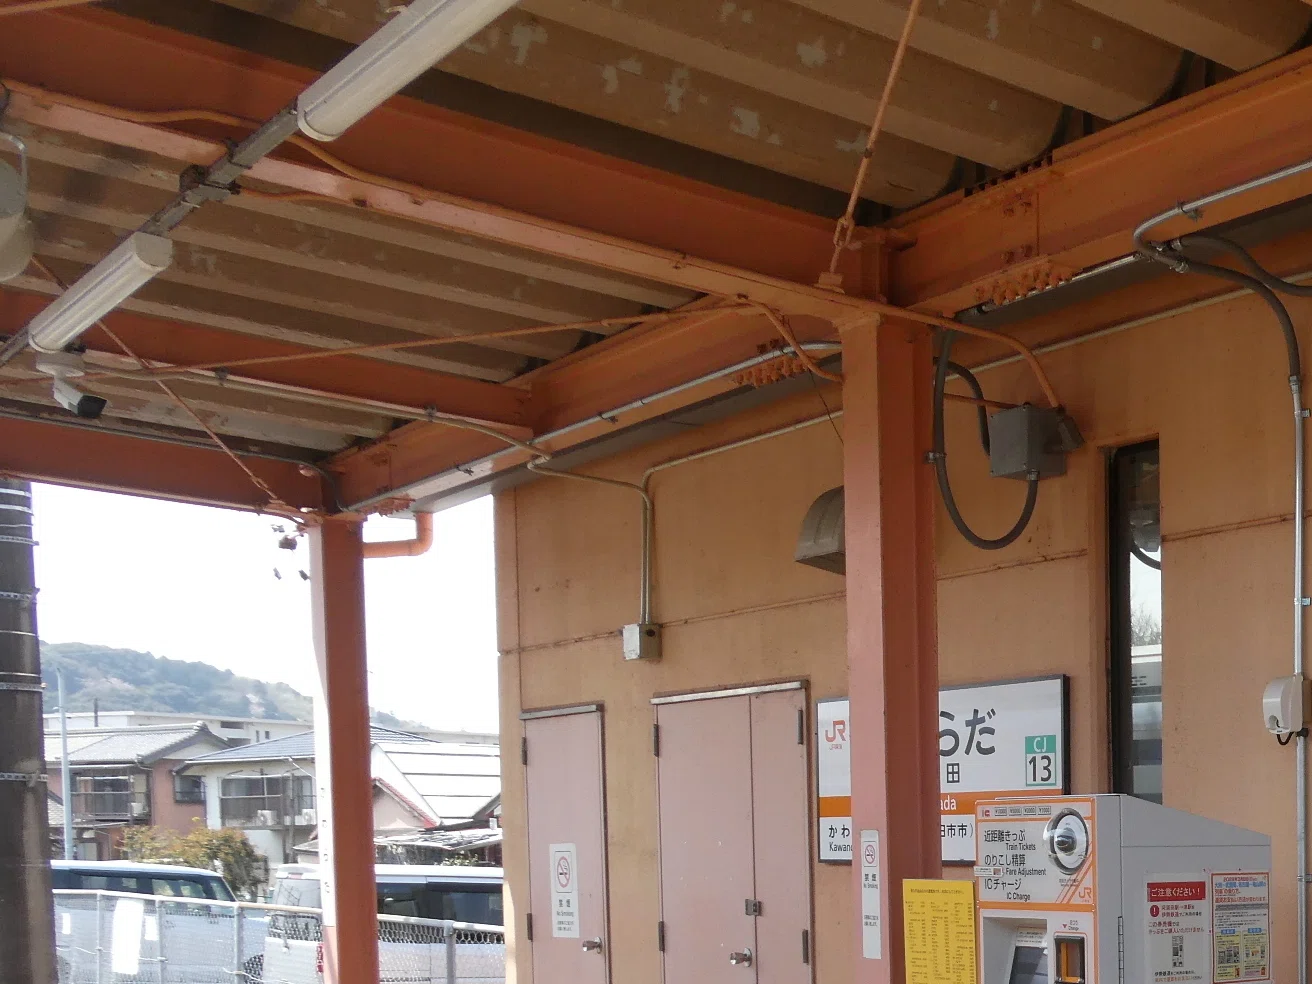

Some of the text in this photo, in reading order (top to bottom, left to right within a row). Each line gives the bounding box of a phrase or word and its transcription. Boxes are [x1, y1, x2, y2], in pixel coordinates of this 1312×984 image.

[825, 720, 846, 742] JR
[1033, 737, 1047, 753] CJ
[946, 763, 960, 783] 田
[1029, 756, 1052, 782] 13
[984, 829, 1026, 842] 近距離きっぷ
[1005, 843, 1036, 851] Train Tickets
[984, 854, 1026, 867] のりこし精算
[1005, 867, 1046, 878] Fare Adjustment
[984, 878, 1022, 890] ICチャージ
[1012, 892, 1031, 902] Charge
[1078, 887, 1092, 899] JR
